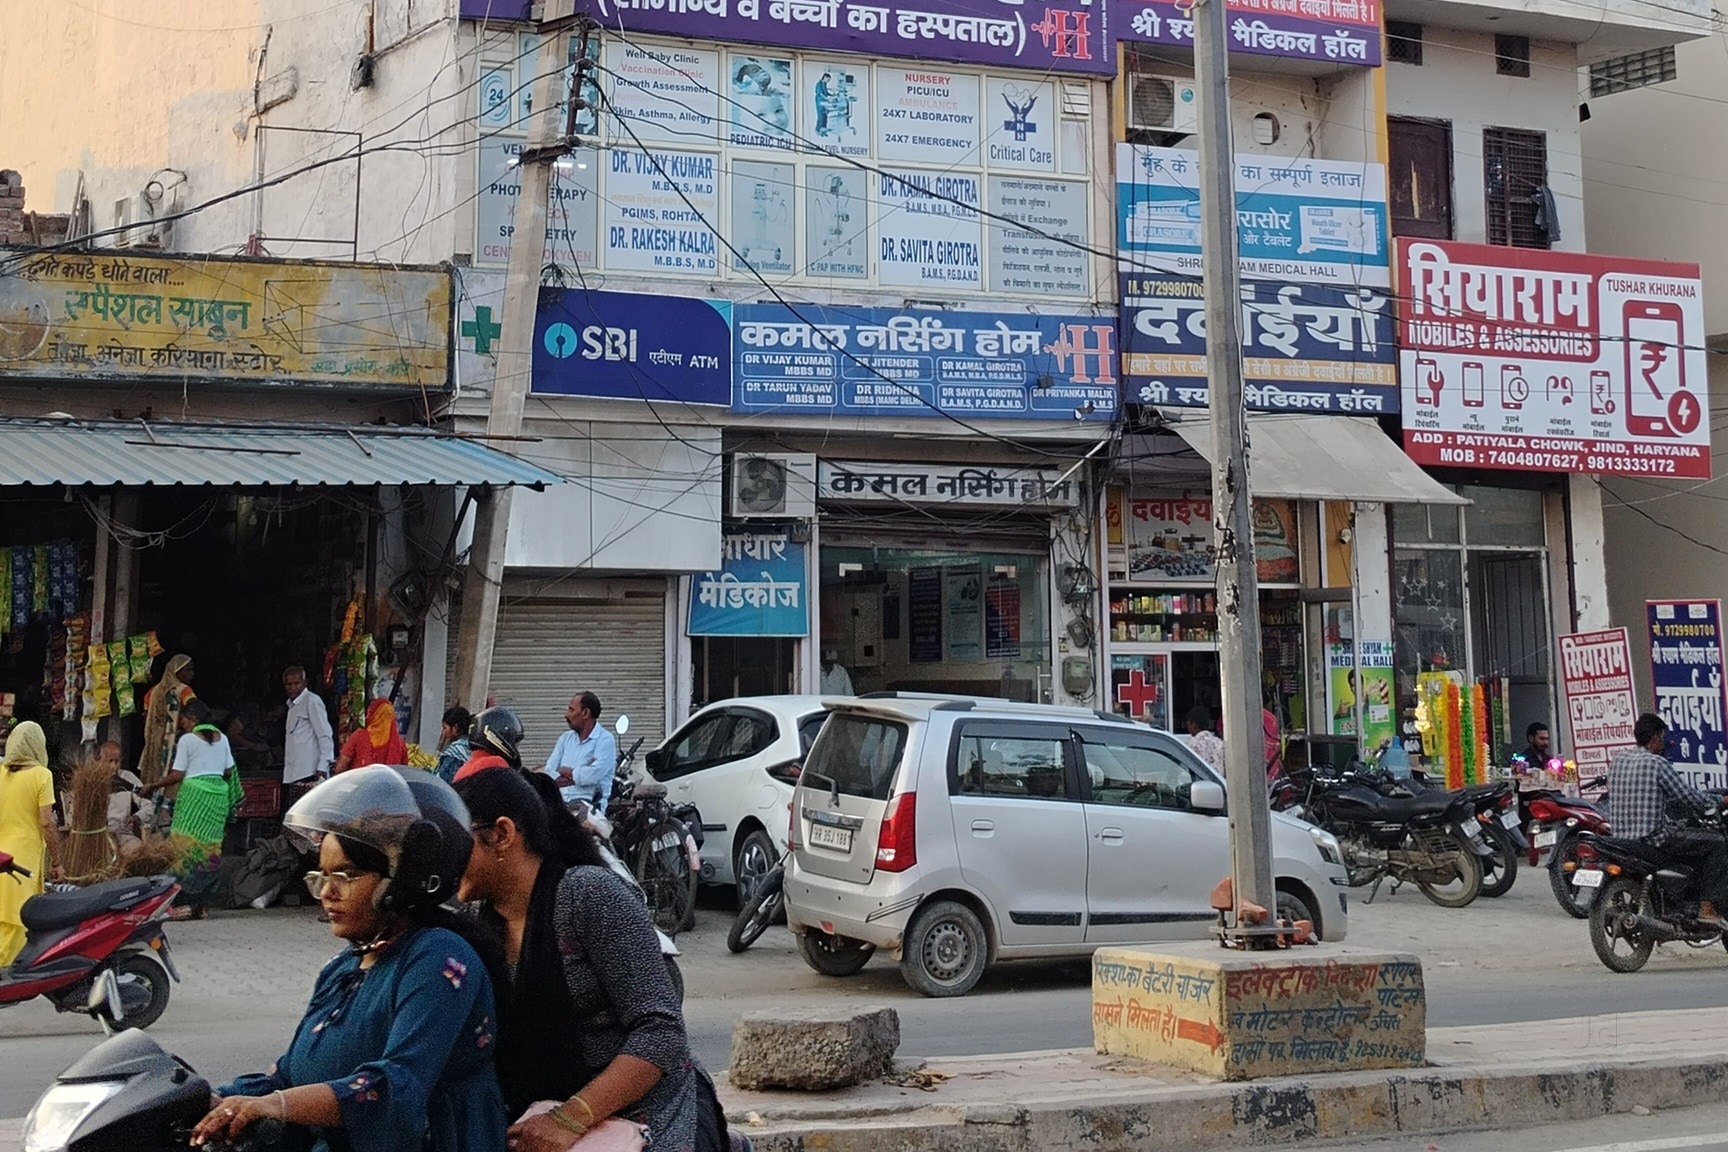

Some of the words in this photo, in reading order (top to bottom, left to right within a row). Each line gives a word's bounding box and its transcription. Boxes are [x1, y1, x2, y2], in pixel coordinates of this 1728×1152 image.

[846, 3, 890, 34] का
[896, 8, 1028, 58] हस्पताल)
[1130, 7, 1161, 38] श्री
[1231, 17, 1317, 55] मैडिकल
[1321, 29, 1367, 59] हॉल
[625, 49, 645, 59] Well
[673, 53, 700, 64] Clinic
[620, 63, 676, 77] Vaccination
[616, 77, 650, 88] Growth
[652, 80, 709, 94] Assessment
[904, 73, 951, 86] NURSERY
[906, 85, 950, 98] PICU/ICU
[897, 97, 959, 111] AMBULANCE
[638, 108, 677, 122] Asthma,
[678, 111, 712, 125] Allergy
[882, 108, 907, 120] 24X7
[908, 110, 974, 125] LABORATORY
[730, 133, 775, 149] PEDIATRIC
[884, 133, 910, 145] 24X7
[911, 135, 973, 149] EMERGENCY
[990, 144, 1026, 162] Critical
[1029, 146, 1053, 164] Care
[634, 152, 668, 176] VIJAY
[671, 155, 713, 180] KUMAR
[1171, 154, 1188, 175] के
[1240, 164, 1262, 182] का
[1269, 164, 1313, 188] सम्पूर्ण
[1319, 170, 1362, 188] इलाज
[899, 174, 932, 199] KAMAL
[934, 176, 978, 203] GIROTRA
[621, 207, 659, 221] PGIMS,
[661, 209, 705, 223] ROHTAK
[1027, 214, 1068, 227] Exchange
[631, 228, 676, 252] RAKESH
[678, 230, 716, 255] KALRA
[900, 238, 935, 265] SAVITA
[936, 239, 979, 267] GIROTRA
[1258, 263, 1307, 276] MEDICAL
[1309, 265, 1338, 278] HALL
[1407, 241, 1593, 327] सियाराम
[1606, 278, 1647, 295] TUSHAR
[1648, 281, 1697, 299] KHURANA
[581, 324, 638, 362] SBI
[739, 321, 850, 351] कमल
[856, 315, 966, 353] नर्सिंग
[973, 320, 1042, 357] होम
[1408, 319, 1475, 347] MOBILES
[1479, 326, 1490, 349] &
[1493, 327, 1593, 357] ASSESSORIES
[649, 348, 682, 367] एटीएम
[689, 355, 719, 370] ATM
[764, 355, 792, 365] VIJAY
[794, 356, 832, 366] KUMAR
[871, 358, 920, 369] JITENDER
[784, 366, 814, 376] MBBS
[816, 367, 832, 377] MD
[955, 361, 983, 371] KAMAL
[985, 362, 1021, 372] GIROTRA
[763, 382, 798, 393] TARUN
[799, 383, 833, 394] YADAV
[956, 388, 985, 398] SAVITA
[986, 388, 1023, 398] GIROTRA
[1045, 388, 1086, 399] PRIYANKA
[1087, 389, 1113, 399] MALIK
[1138, 380, 1169, 404] श्री
[1336, 389, 1384, 412] हॉल
[785, 394, 815, 404] MBBS
[817, 395, 833, 404] MD
[1412, 433, 1444, 445] ADD
[1456, 434, 1527, 449] PATIYALA
[1529, 437, 1587, 453] CHOWK,
[1592, 441, 1630, 456] JIND,
[1632, 443, 1700, 458] HARYANA
[1440, 448, 1476, 463] MOB
[1488, 450, 1584, 471] 7404807627,
[1587, 457, 1676, 473] 9813333172
[830, 471, 928, 496] कमल
[936, 468, 1018, 498] नर्सिंग
[698, 571, 800, 609] मेडिकोज
[1664, 623, 1715, 637] 9729980700
[1374, 656, 1393, 667] HALL
[1561, 637, 1627, 679] सियाराम
[1655, 666, 1722, 740] दवाईयाँ
